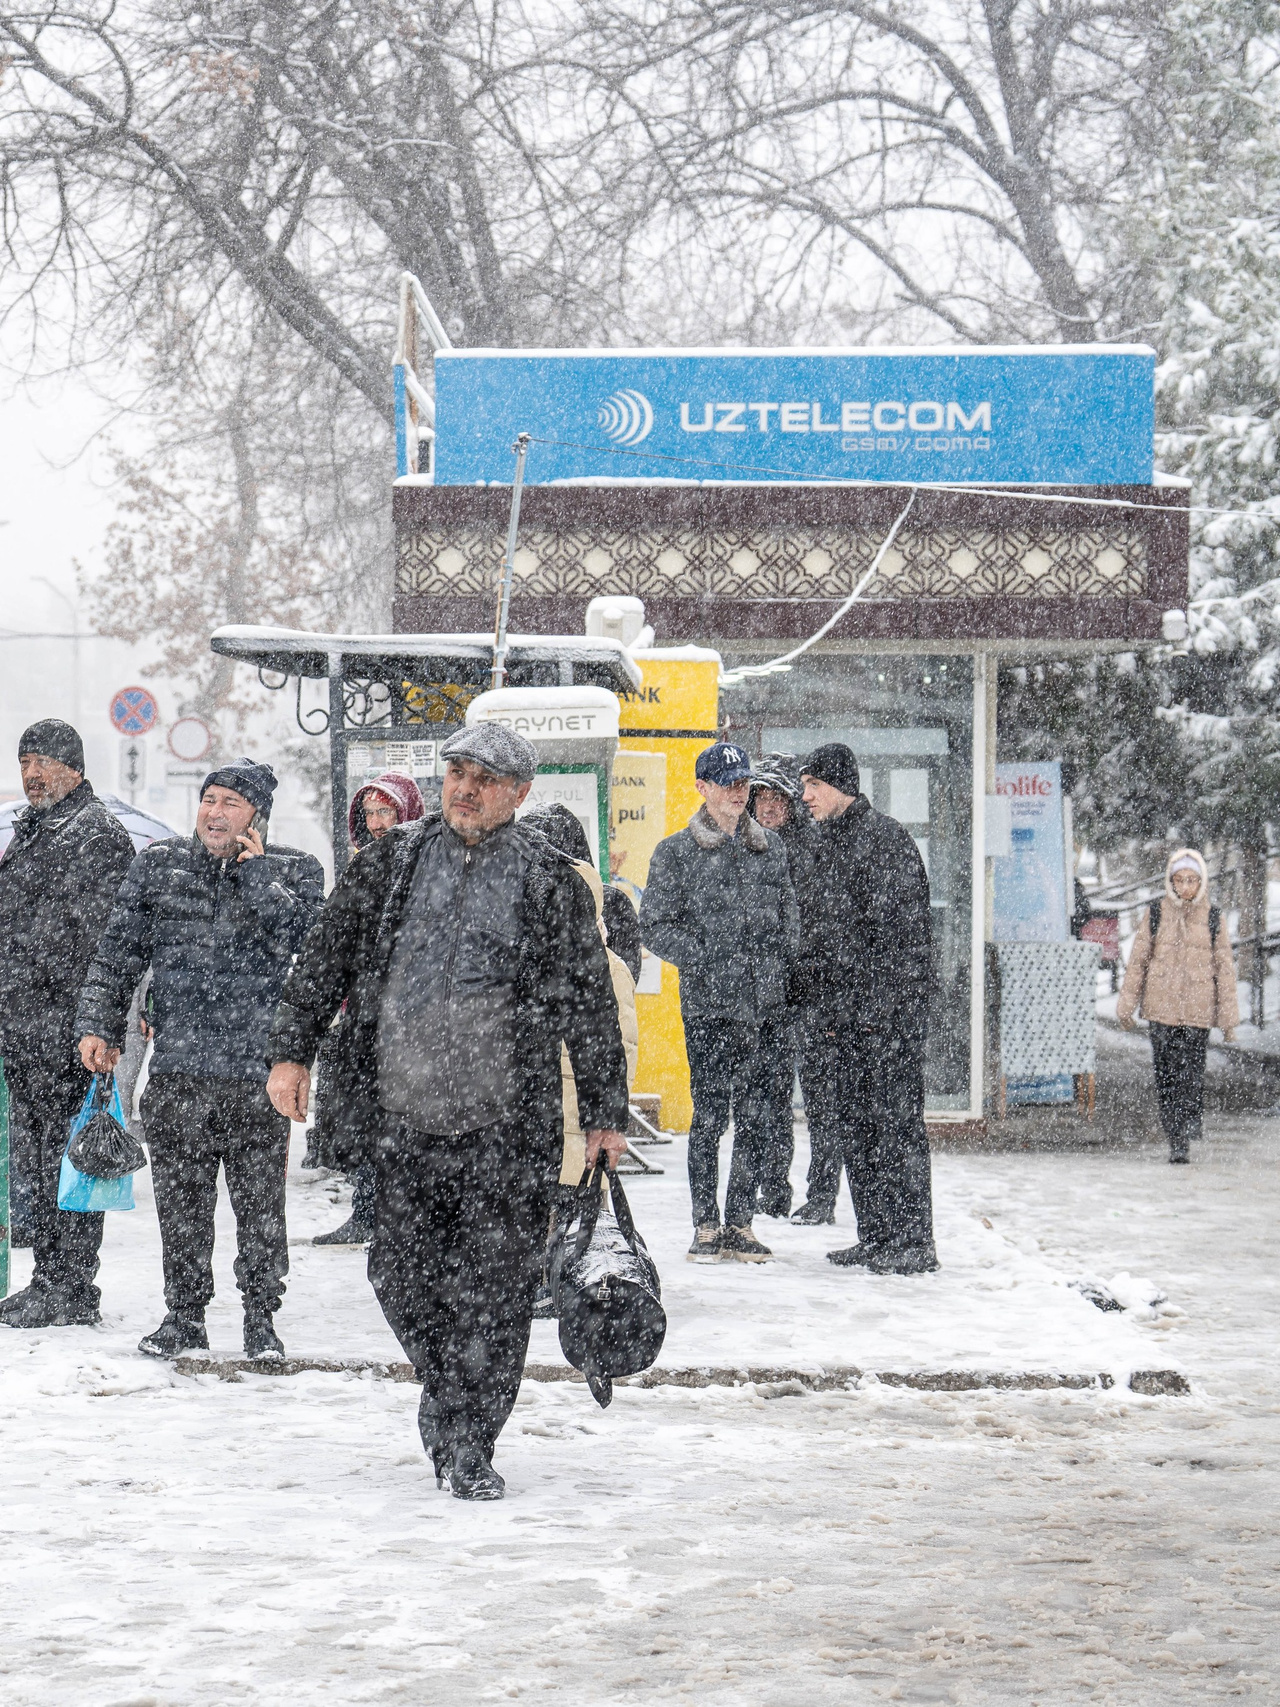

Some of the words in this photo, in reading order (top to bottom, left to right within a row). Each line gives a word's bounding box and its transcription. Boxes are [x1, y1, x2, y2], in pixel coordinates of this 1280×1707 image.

[680, 401, 992, 433] UZTELECOM
[617, 687, 661, 703] ANK
[723, 747, 741, 764] NY
[995, 774, 1052, 797] iolife
[526, 790, 547, 802] AY
[553, 789, 584, 801] PUL
[618, 805, 646, 824] pul
